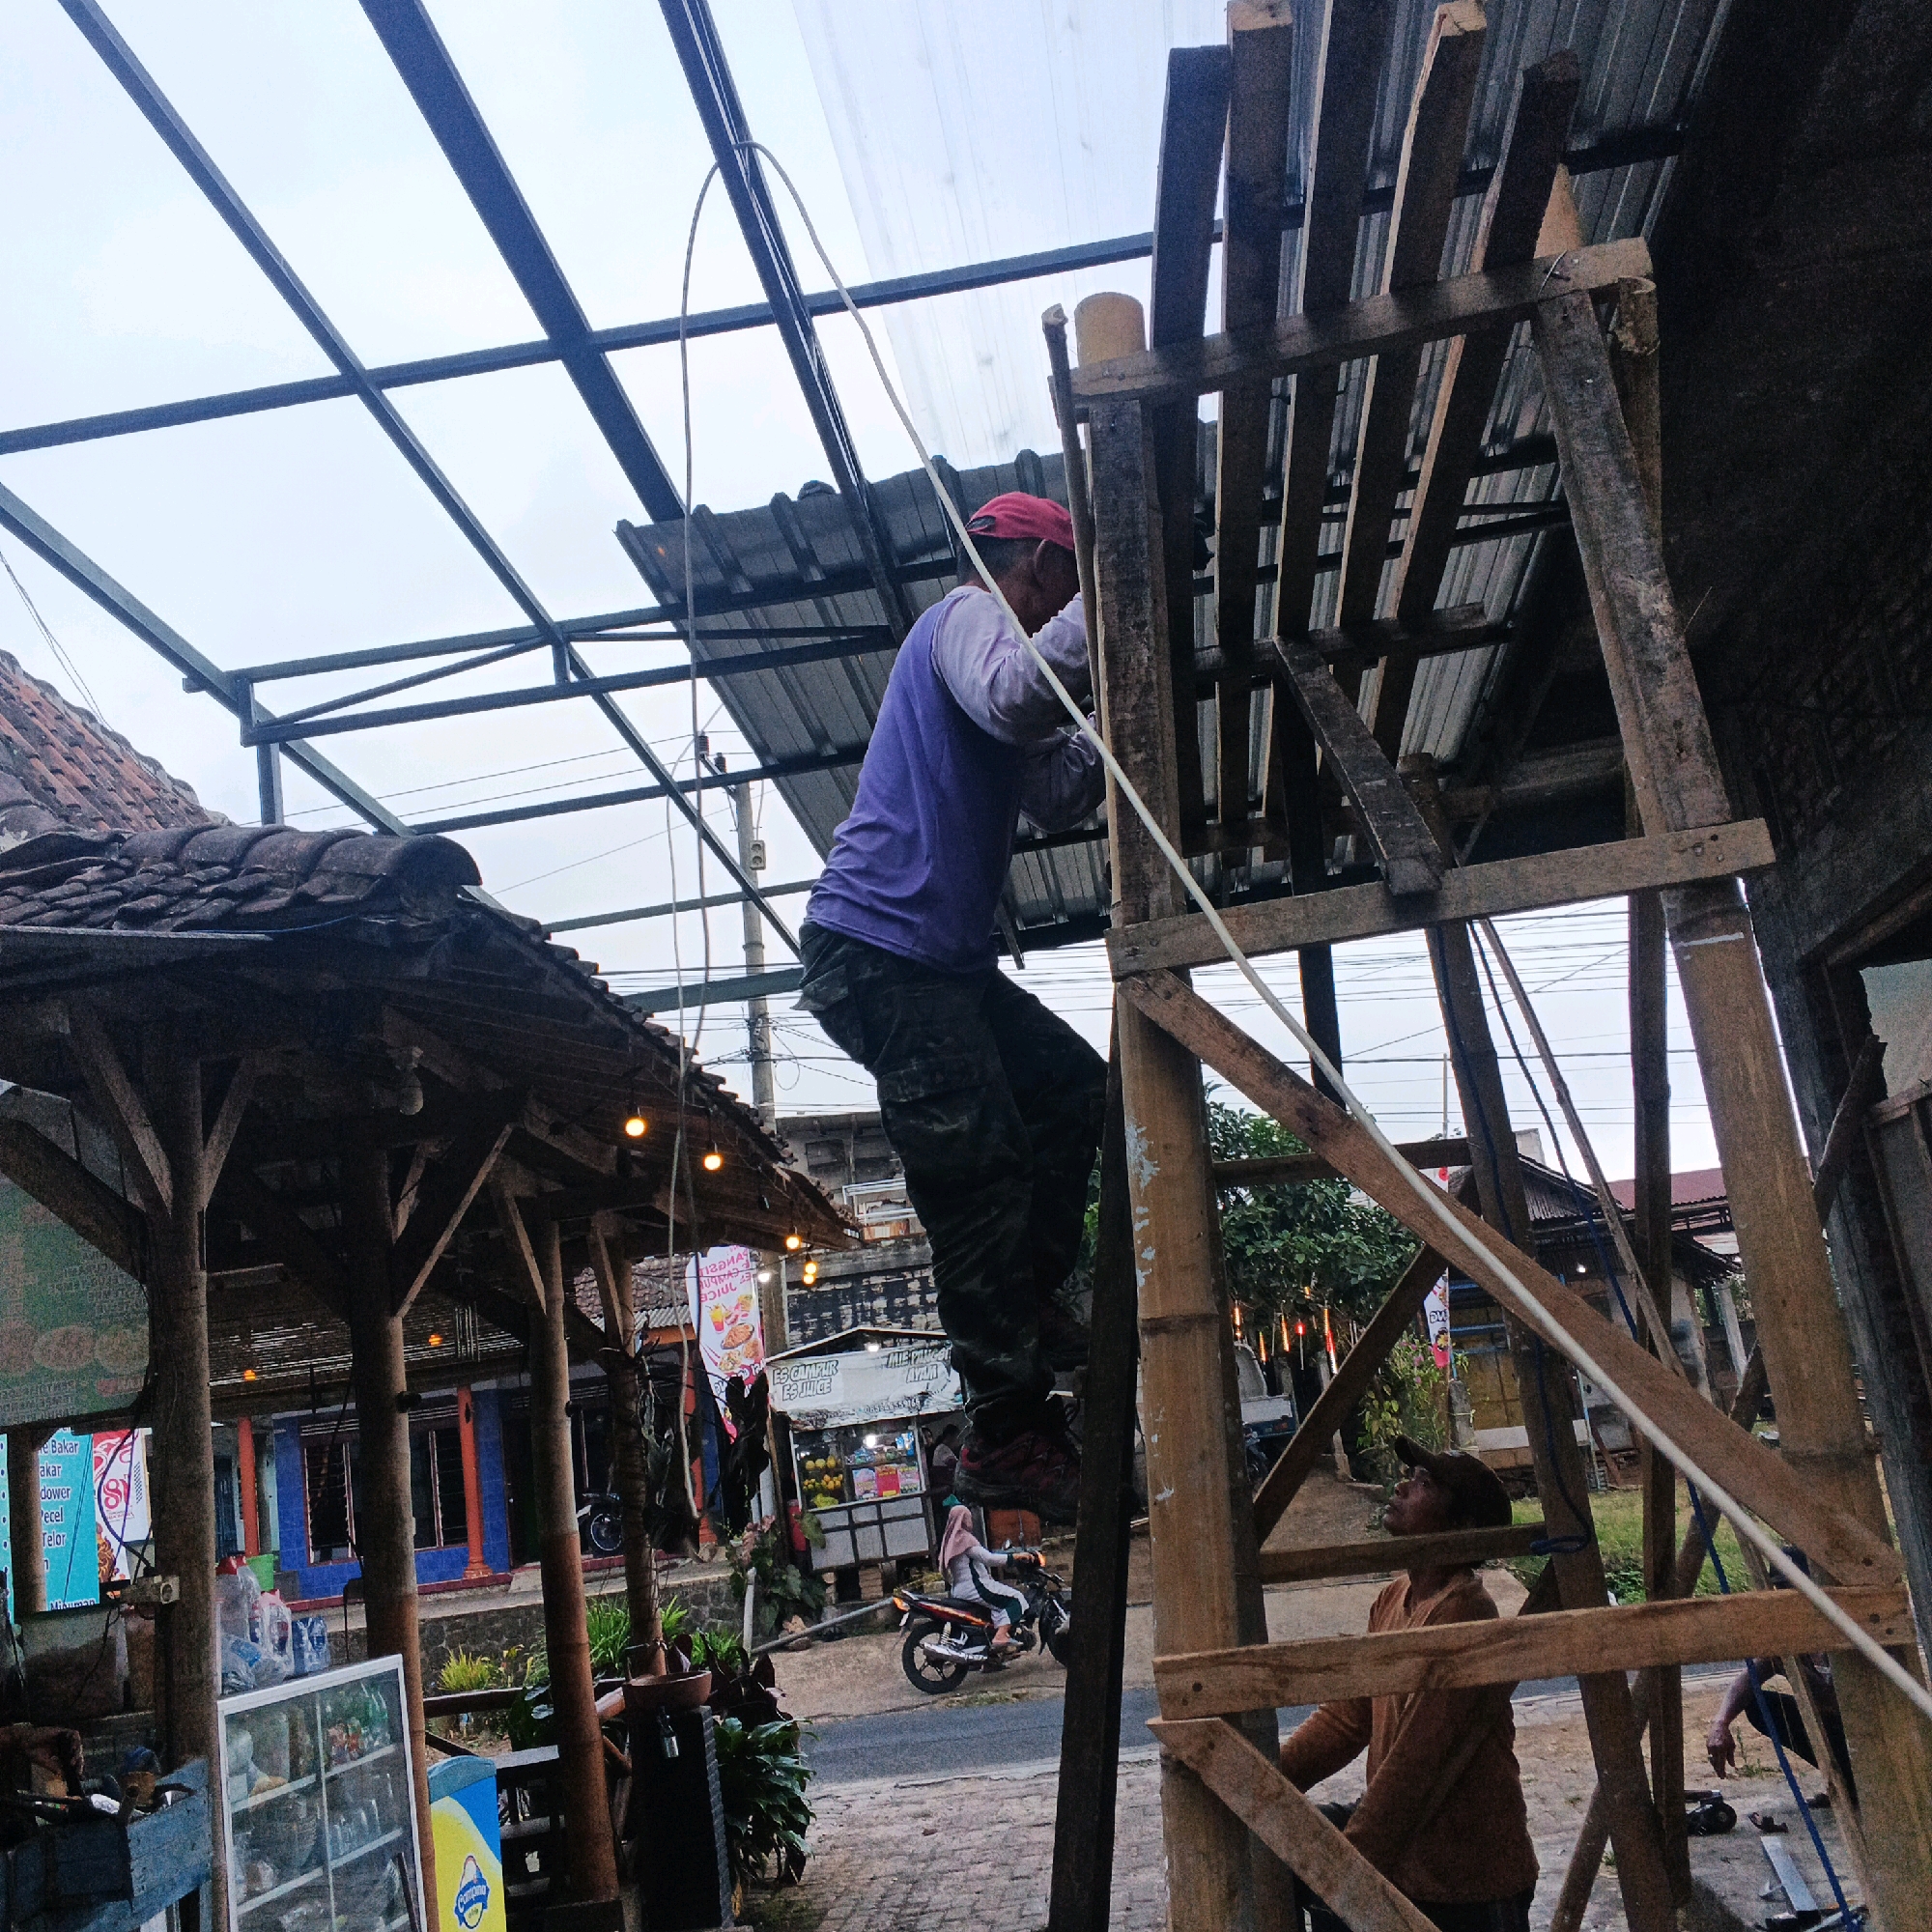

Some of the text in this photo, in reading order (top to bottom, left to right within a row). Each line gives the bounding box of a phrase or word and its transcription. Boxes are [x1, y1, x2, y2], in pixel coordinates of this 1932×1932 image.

[910, 1347, 952, 1366] PANGSI
[772, 1359, 838, 1385] ES CAMPUR
[906, 1363, 938, 1383] AYAM
[781, 1377, 833, 1402] ES JUICE
[51, 1437, 79, 1454] Bakar
[40, 1462, 62, 1477] akar
[42, 1530, 67, 1548] Telor
[458, 1885, 487, 1914] Campina
